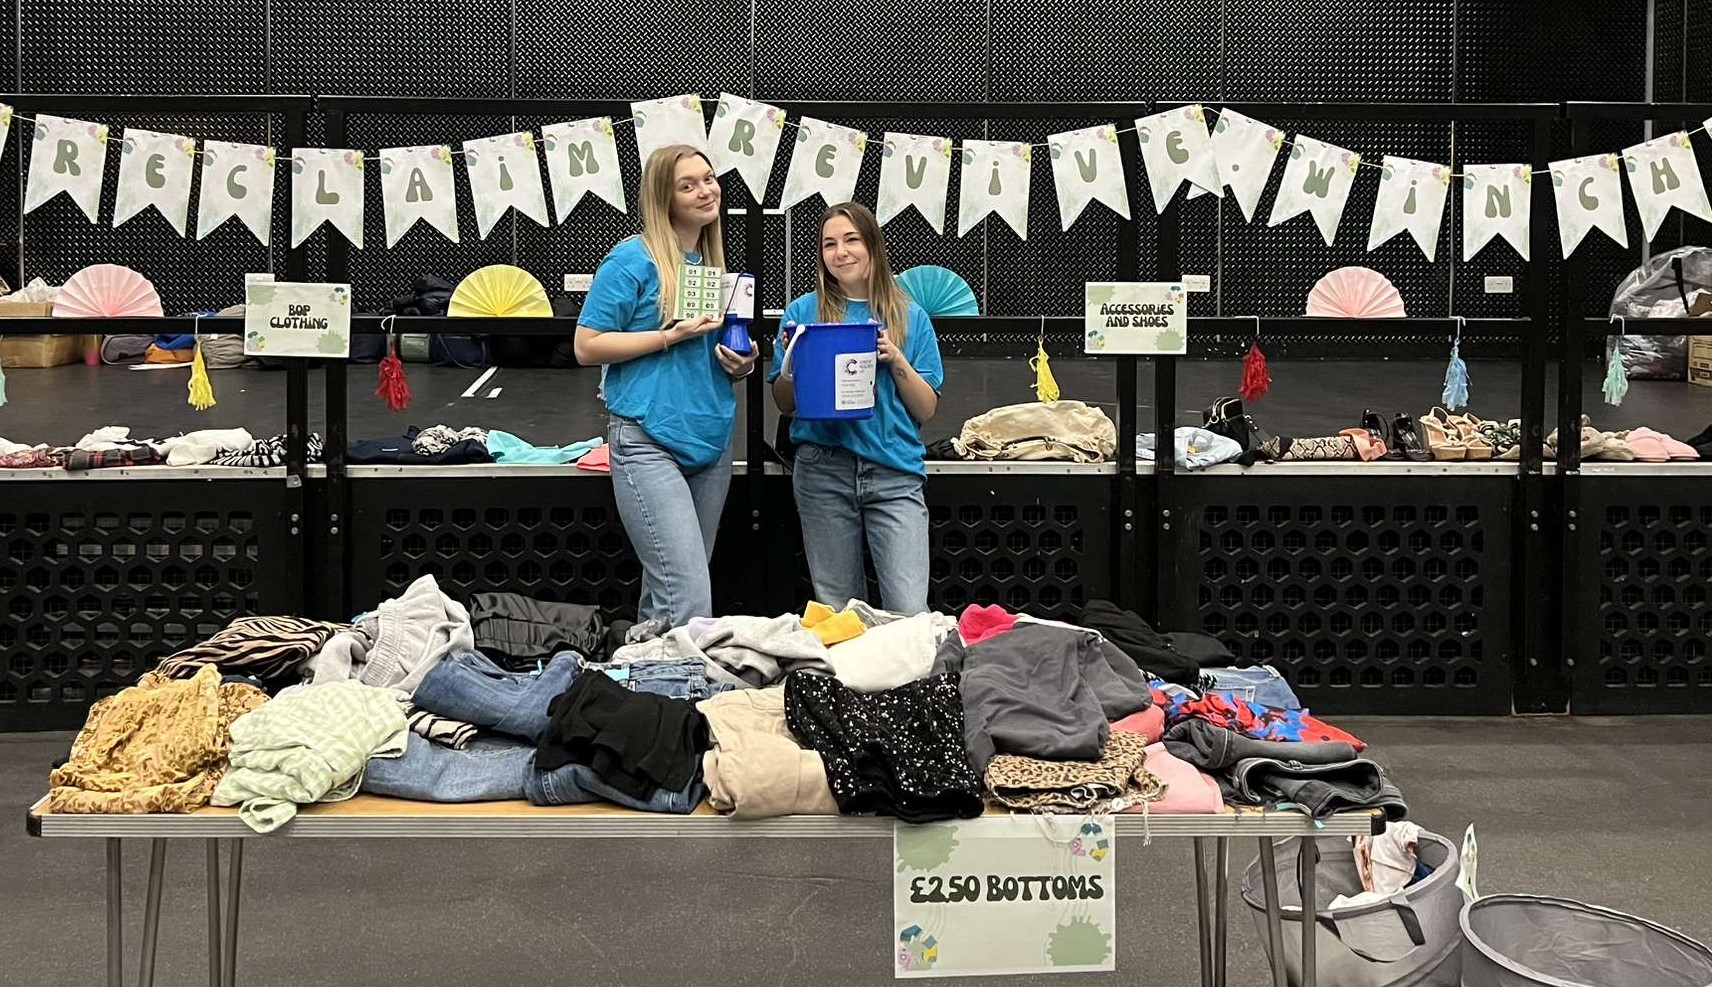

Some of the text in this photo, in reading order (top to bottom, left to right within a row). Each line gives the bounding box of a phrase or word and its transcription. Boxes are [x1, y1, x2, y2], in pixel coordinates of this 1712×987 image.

[288, 304, 311, 316] BOP
[1106, 316, 1169, 327] AND SHOES
[986, 874, 1104, 901] BOTTOMS
